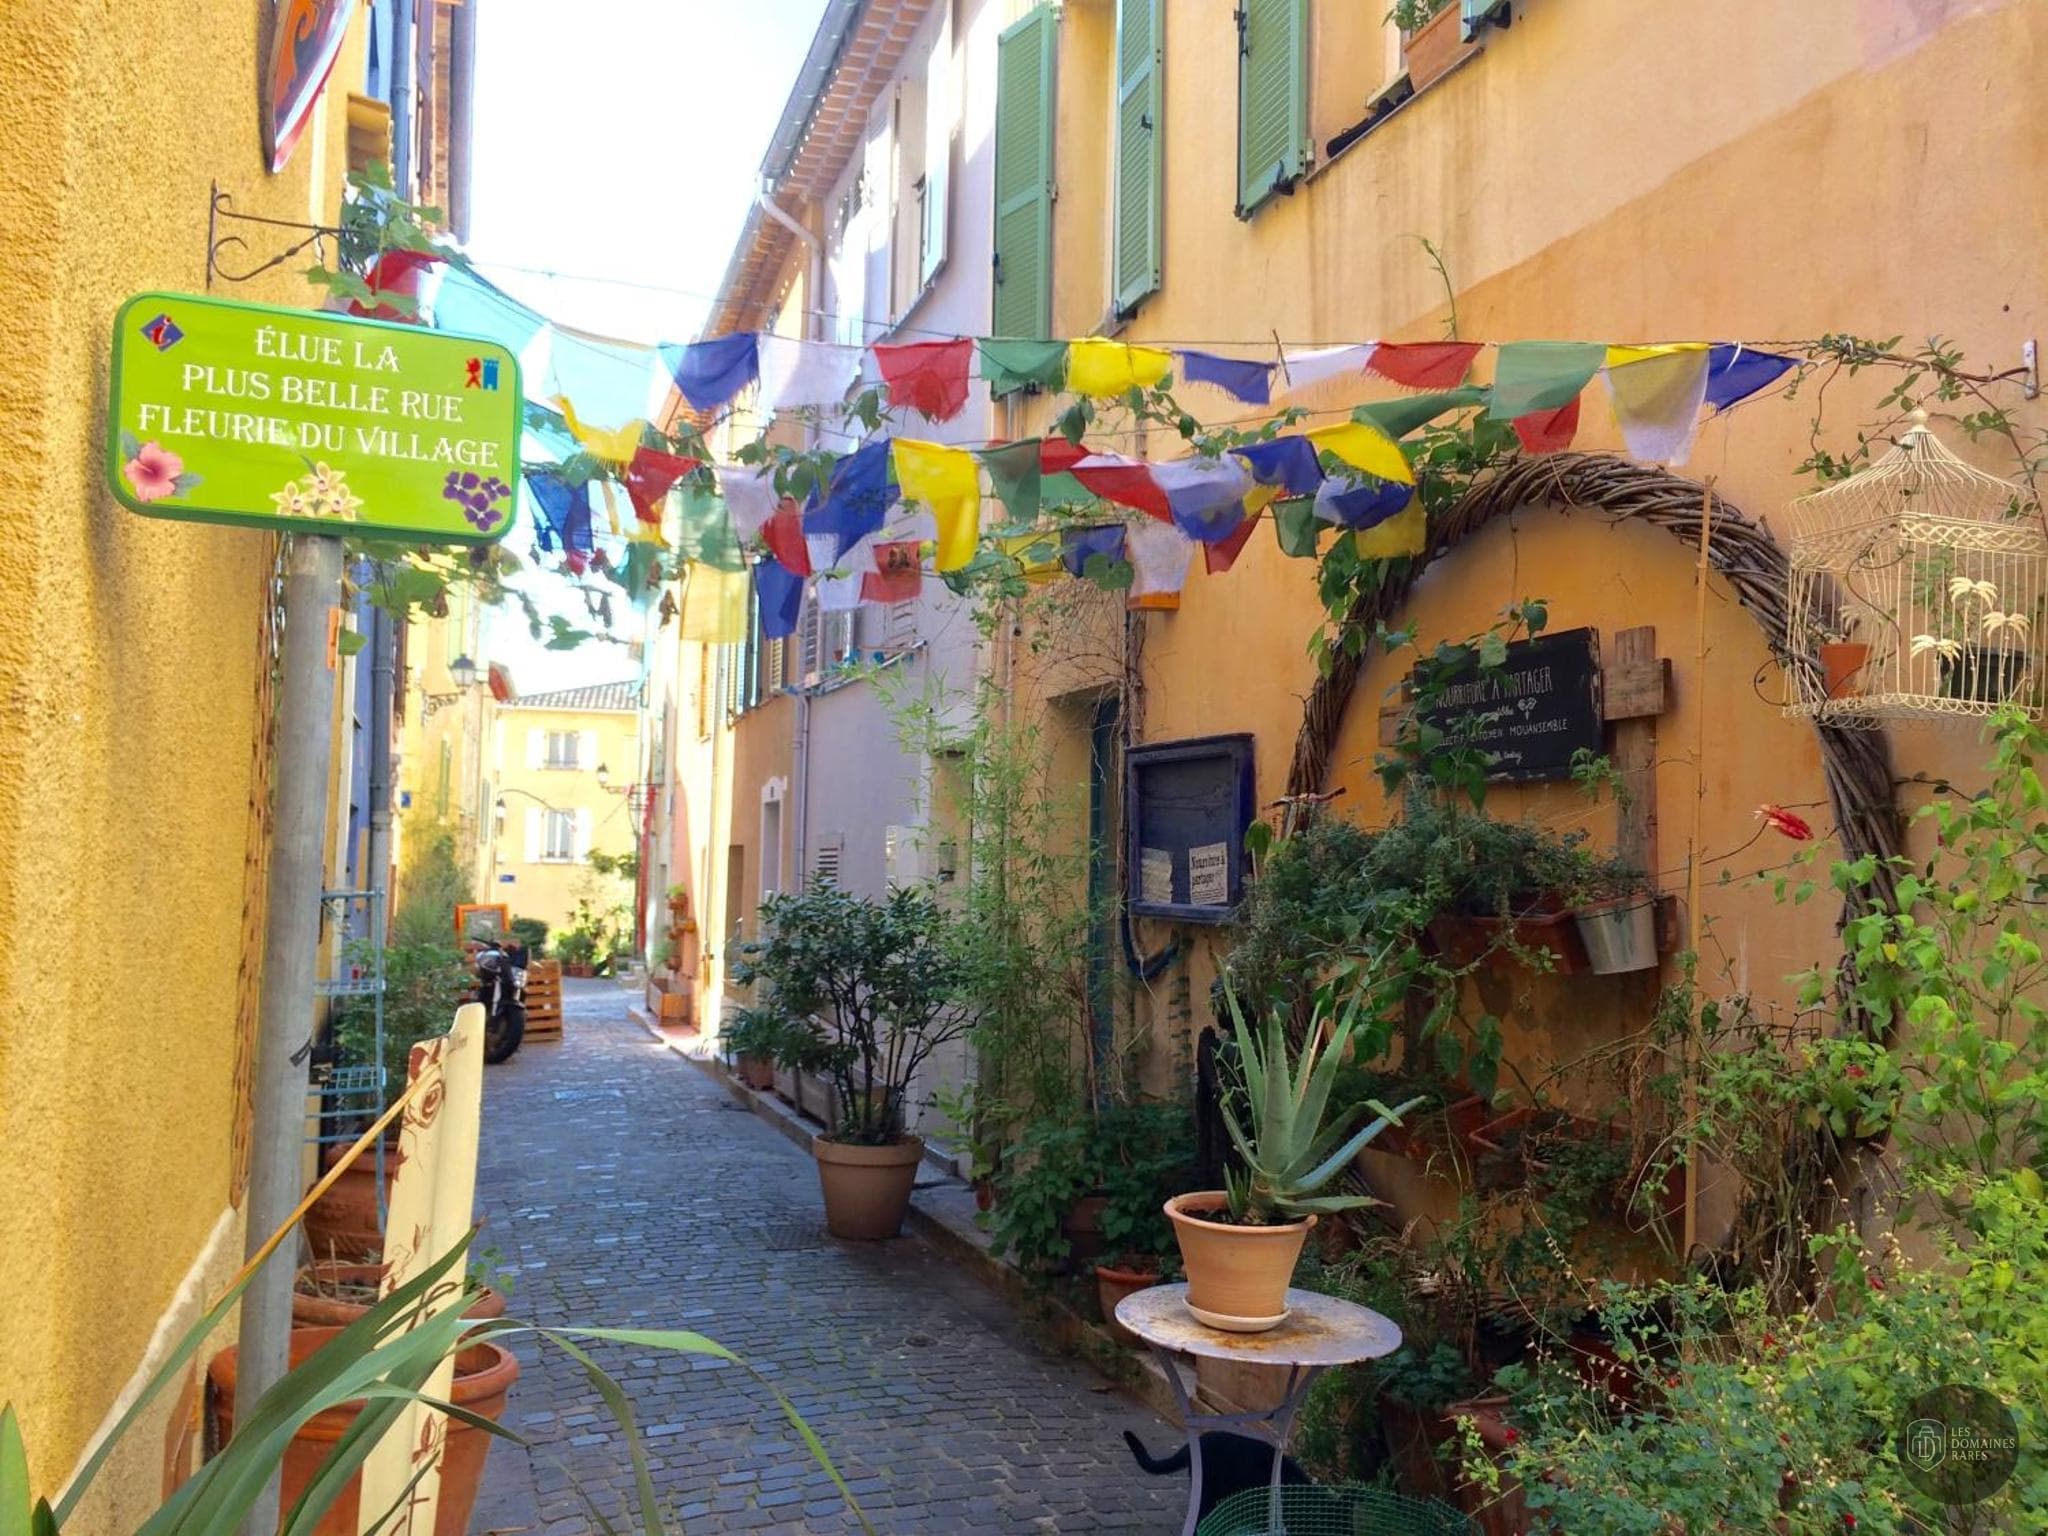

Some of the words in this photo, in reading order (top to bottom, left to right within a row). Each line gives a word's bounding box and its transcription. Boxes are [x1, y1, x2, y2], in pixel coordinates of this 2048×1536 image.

[255, 325, 342, 366] ÉLUE
[353, 341, 401, 373] LA
[182, 363, 271, 401] PLUS
[281, 376, 390, 415] BELLE
[401, 390, 464, 423] RUE
[138, 403, 291, 447] FLEURIE
[299, 421, 345, 452] DU
[355, 425, 500, 469] VILLAGE
